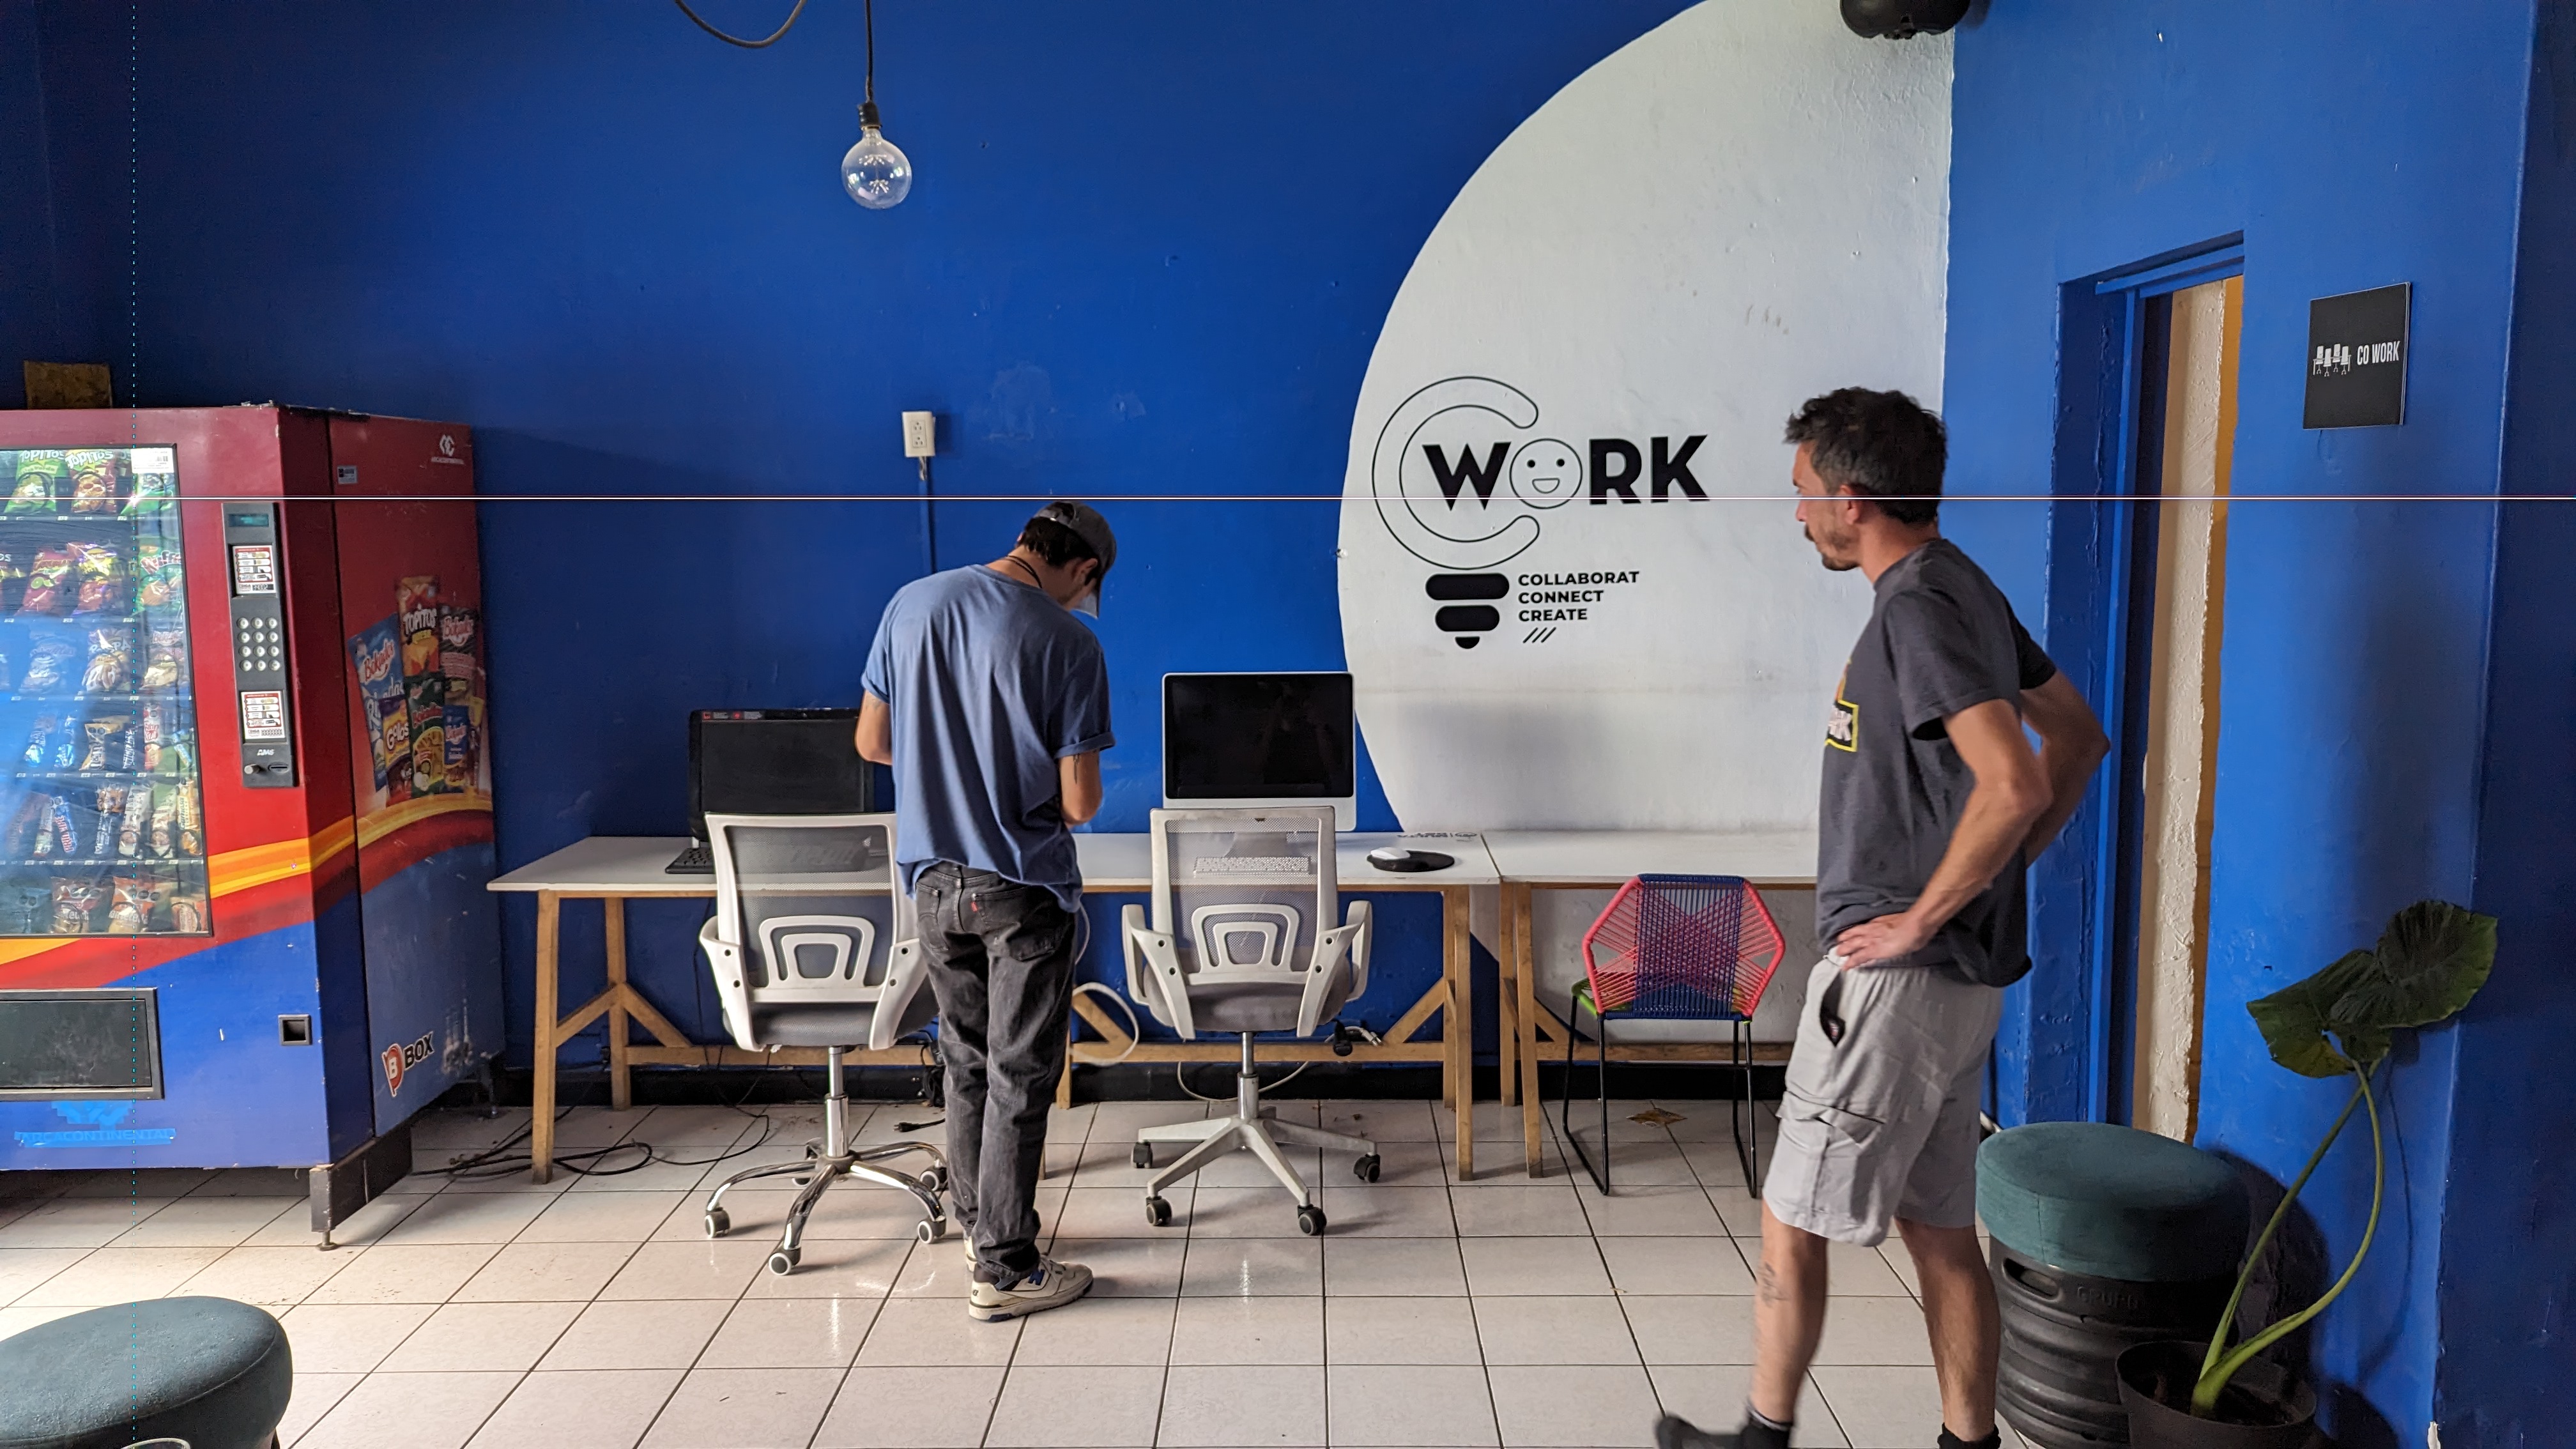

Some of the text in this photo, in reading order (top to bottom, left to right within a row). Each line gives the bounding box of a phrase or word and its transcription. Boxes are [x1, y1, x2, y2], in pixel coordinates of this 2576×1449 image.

[2358, 341, 2400, 365] CO WORK
[1518, 571, 1640, 586] COLLABORAT
[1518, 590, 1604, 604] CONNECT
[1518, 608, 1588, 622] CREATE
[403, 1031, 434, 1071] BOX
